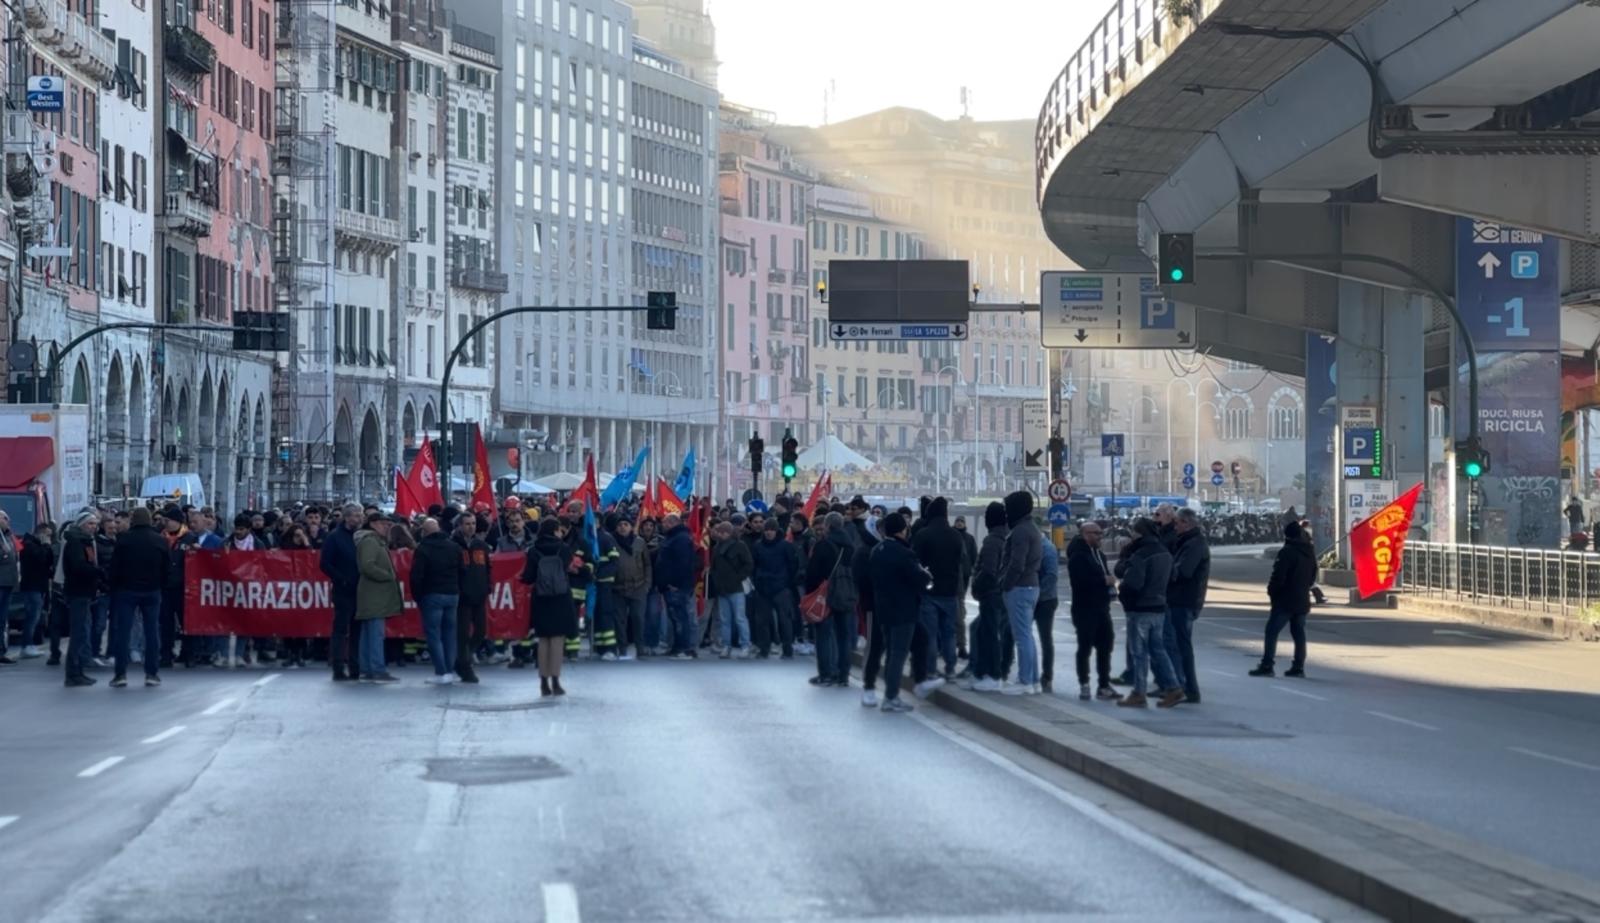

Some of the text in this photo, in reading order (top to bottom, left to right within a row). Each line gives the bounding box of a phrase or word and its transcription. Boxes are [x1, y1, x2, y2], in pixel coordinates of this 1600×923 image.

[1501, 230, 1543, 243] DI GENOVA
[1518, 255, 1533, 274] P
[1148, 298, 1168, 325] P
[1487, 296, 1530, 336] -1
[871, 327, 893, 335] Ferrari
[1479, 409, 1544, 418] IDUCI, RIUSA
[1485, 420, 1545, 433] RICICLA
[1353, 437, 1366, 455] P
[1352, 495, 1361, 507] P
[200, 579, 335, 610] RIPARAZION
